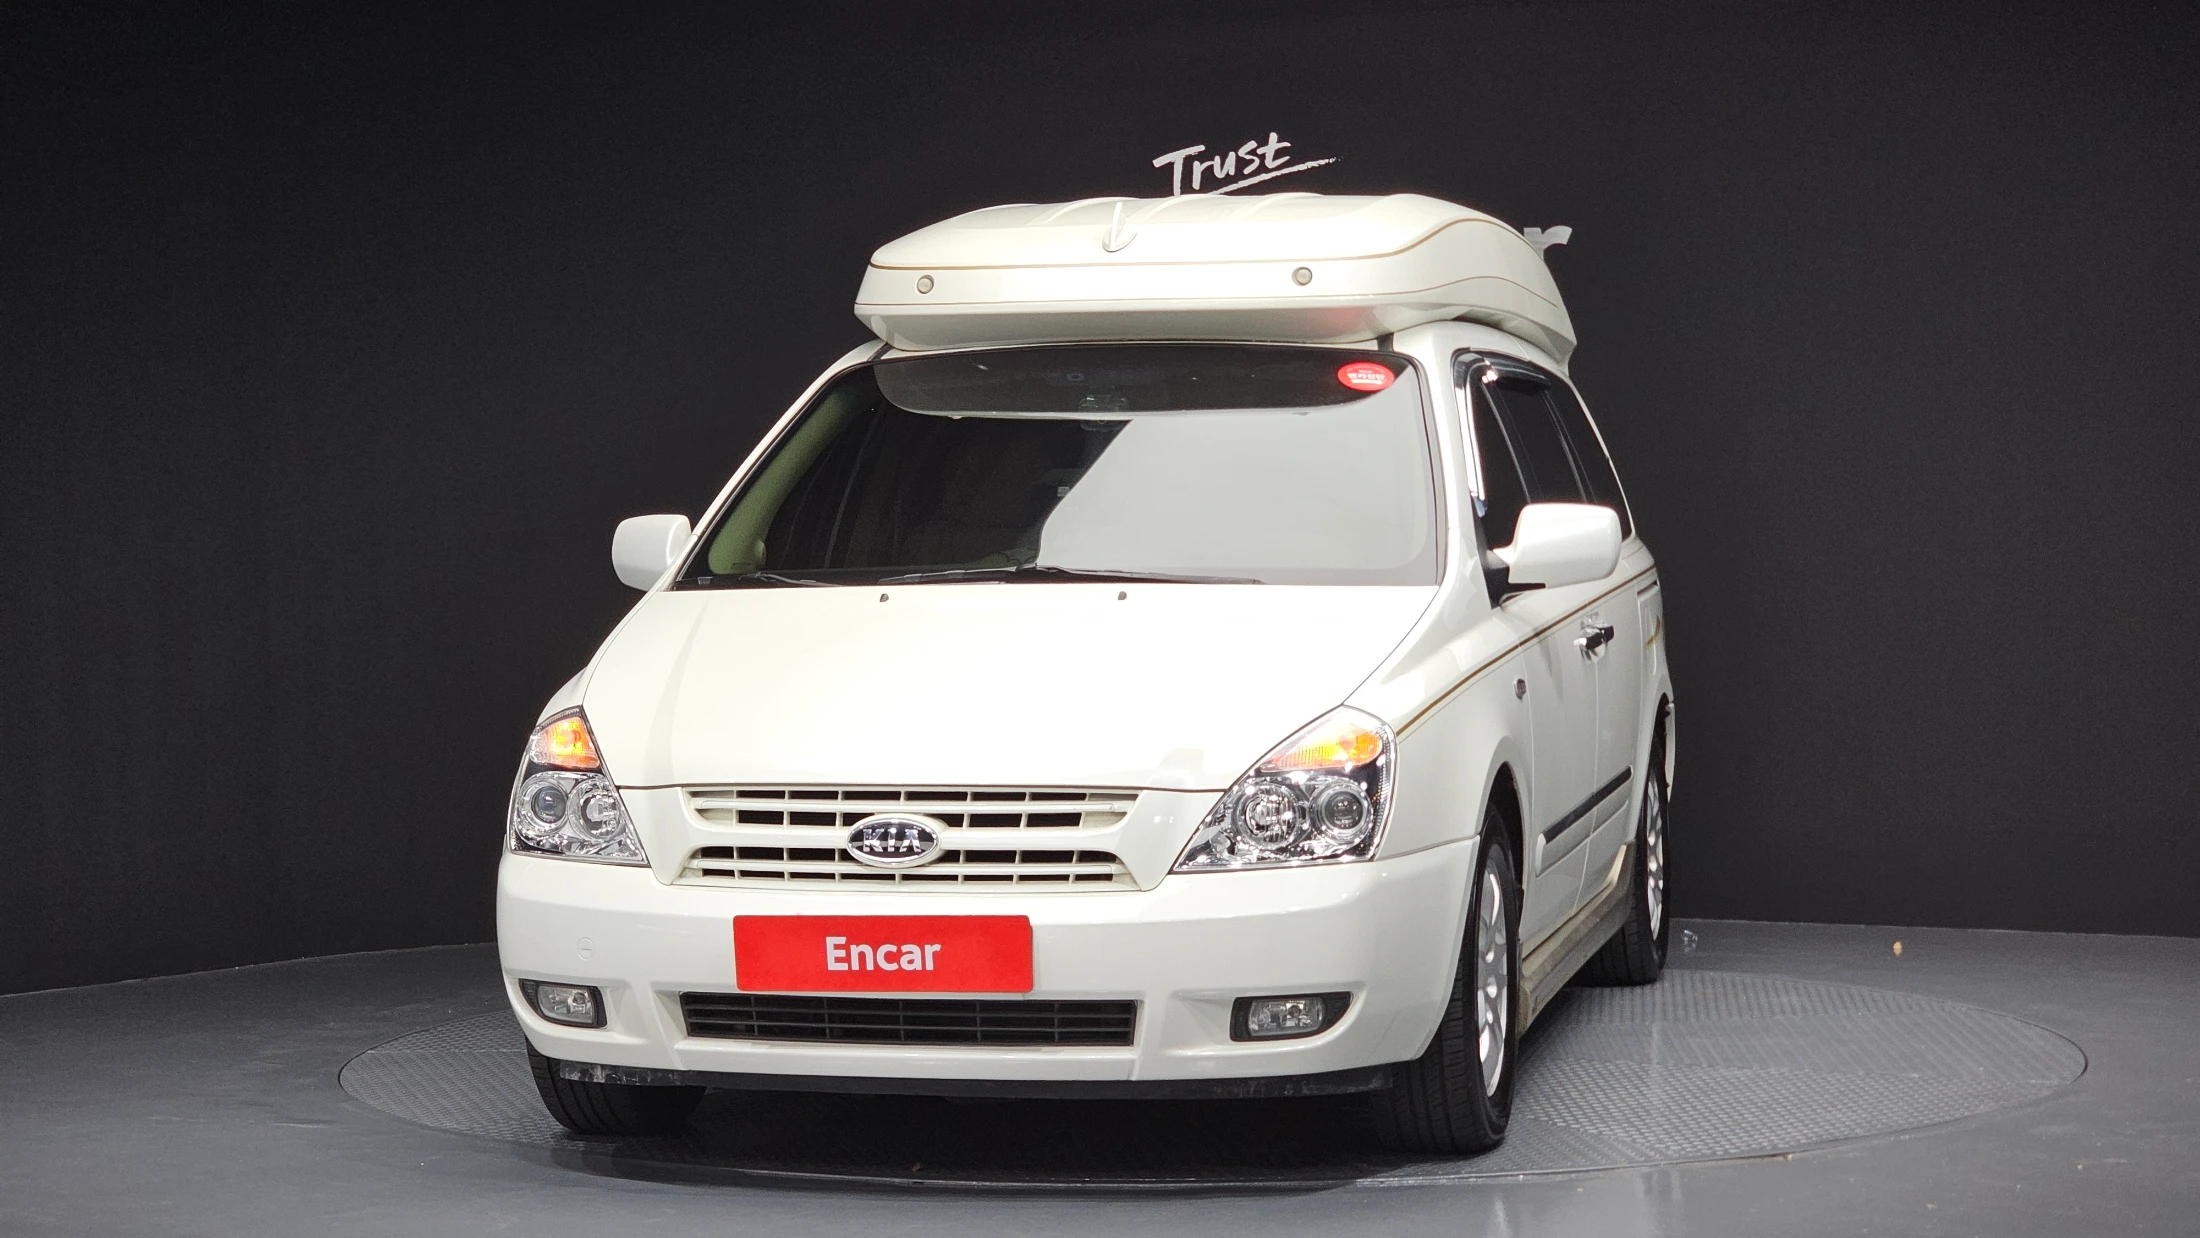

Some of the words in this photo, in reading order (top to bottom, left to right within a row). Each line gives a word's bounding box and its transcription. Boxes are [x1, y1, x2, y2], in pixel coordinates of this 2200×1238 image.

[1152, 132, 1292, 196] Trust
[863, 828, 922, 853] KIA
[825, 936, 941, 971] Encar
